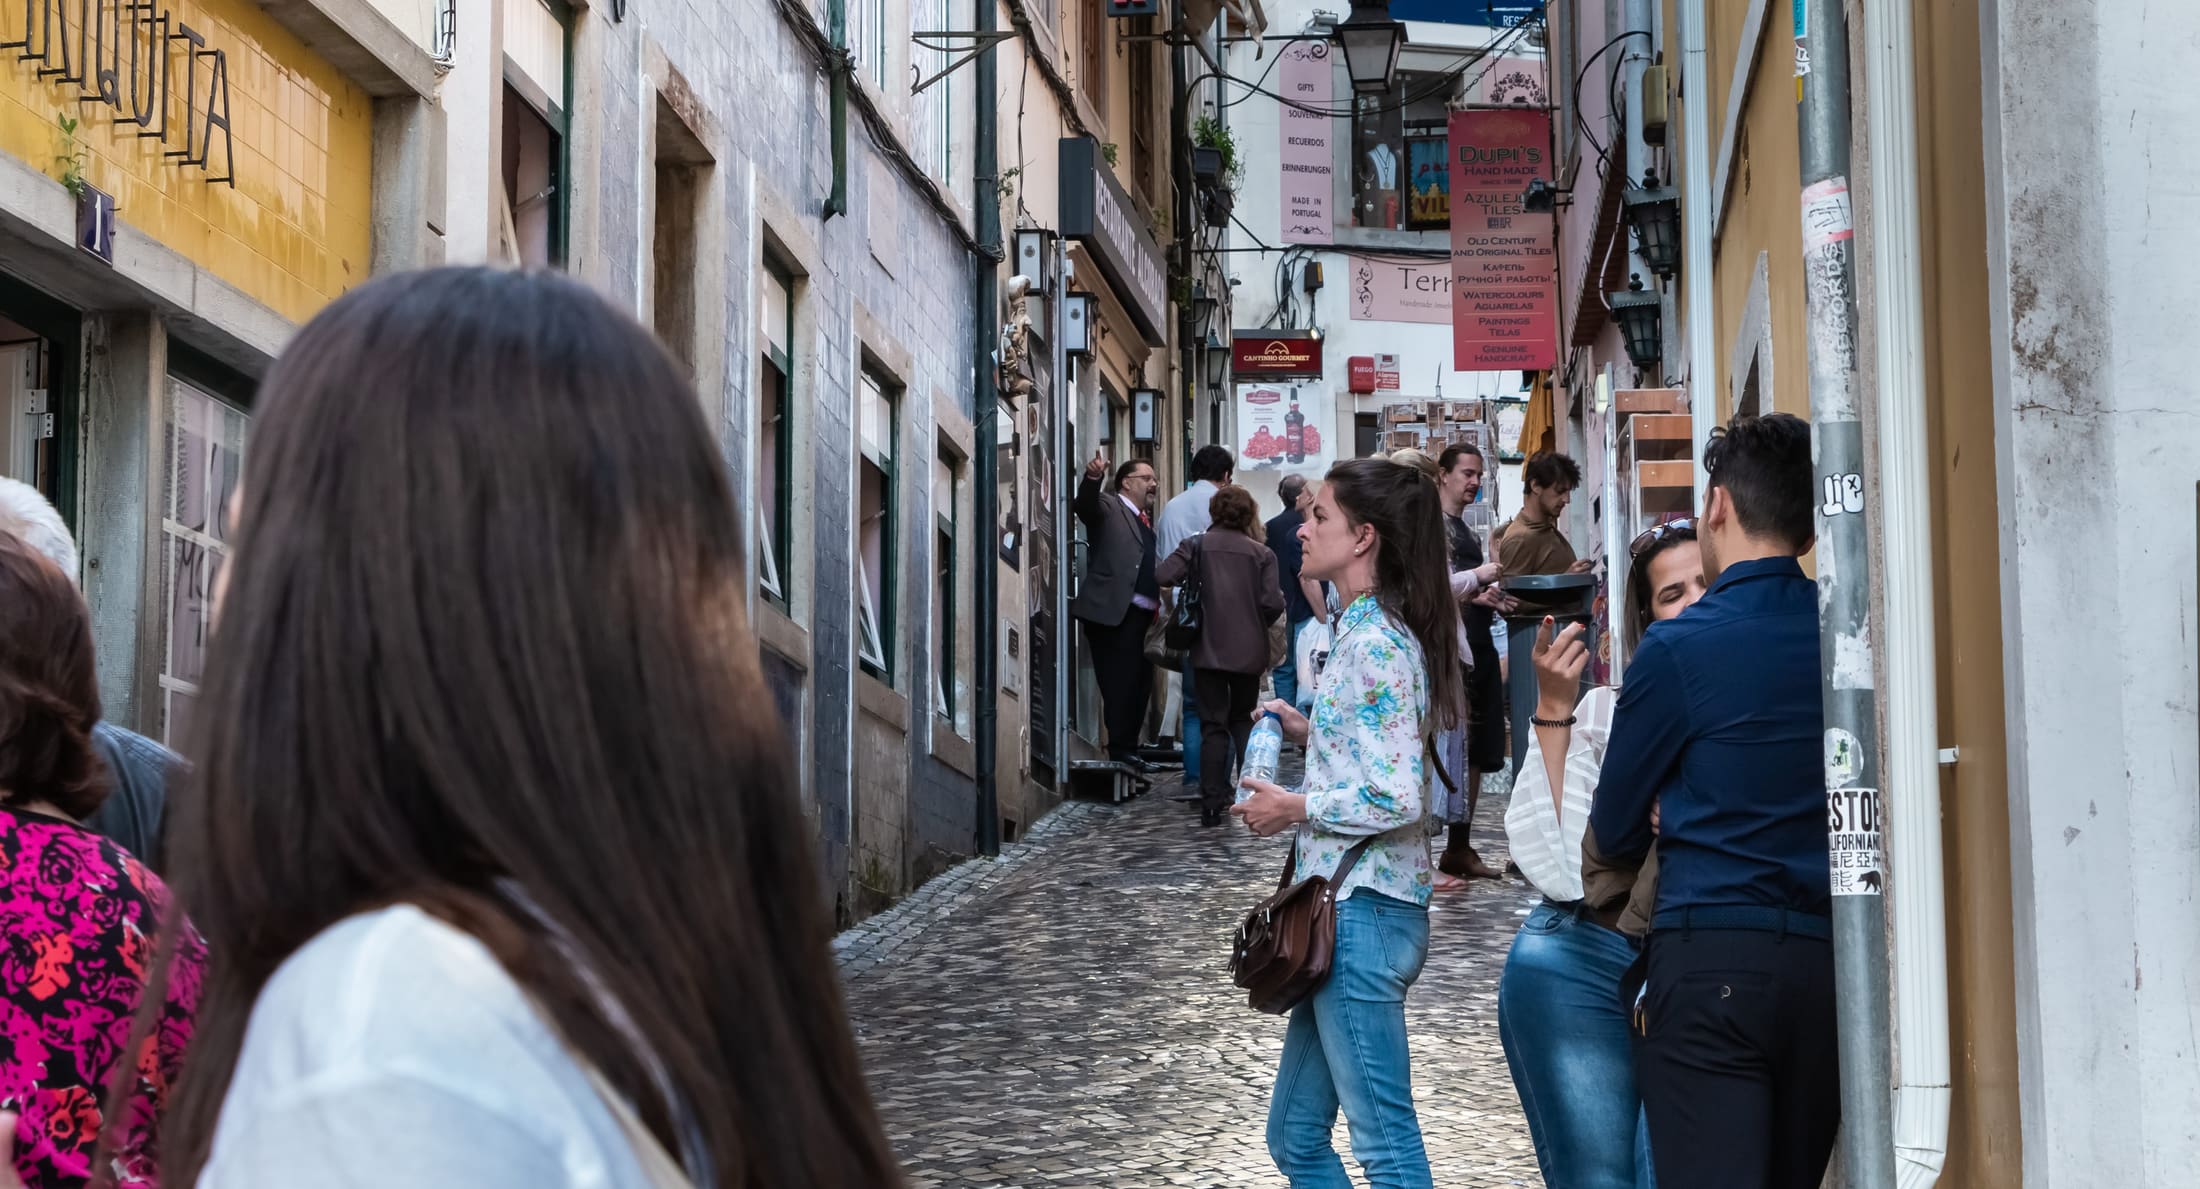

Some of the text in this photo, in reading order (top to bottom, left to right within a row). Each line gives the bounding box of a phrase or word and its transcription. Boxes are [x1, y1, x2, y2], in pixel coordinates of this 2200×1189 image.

[1297, 83, 1314, 92] GIFTS
[1288, 136, 1325, 147] RECUERDOS
[1459, 145, 1542, 164] DUPI'S
[1282, 163, 1331, 174] ERINNERUNGEN
[1464, 166, 1538, 176] HAND MADE
[1291, 196, 1309, 205] MADE
[1291, 209, 1322, 218] PORTUGAL
[1480, 205, 1521, 215] TILES
[94, 194, 102, 250] 1
[1467, 236, 1536, 246] OLD CENTURY
[1453, 247, 1552, 257] AND ORIGINAL TILES
[1463, 291, 1544, 300] WATERCOLOURS
[1478, 317, 1530, 326] PAINTINGS
[1488, 328, 1521, 337] TELAS
[1482, 344, 1528, 353] GENUINE
[1474, 354, 1536, 363] HANDCRAFT
